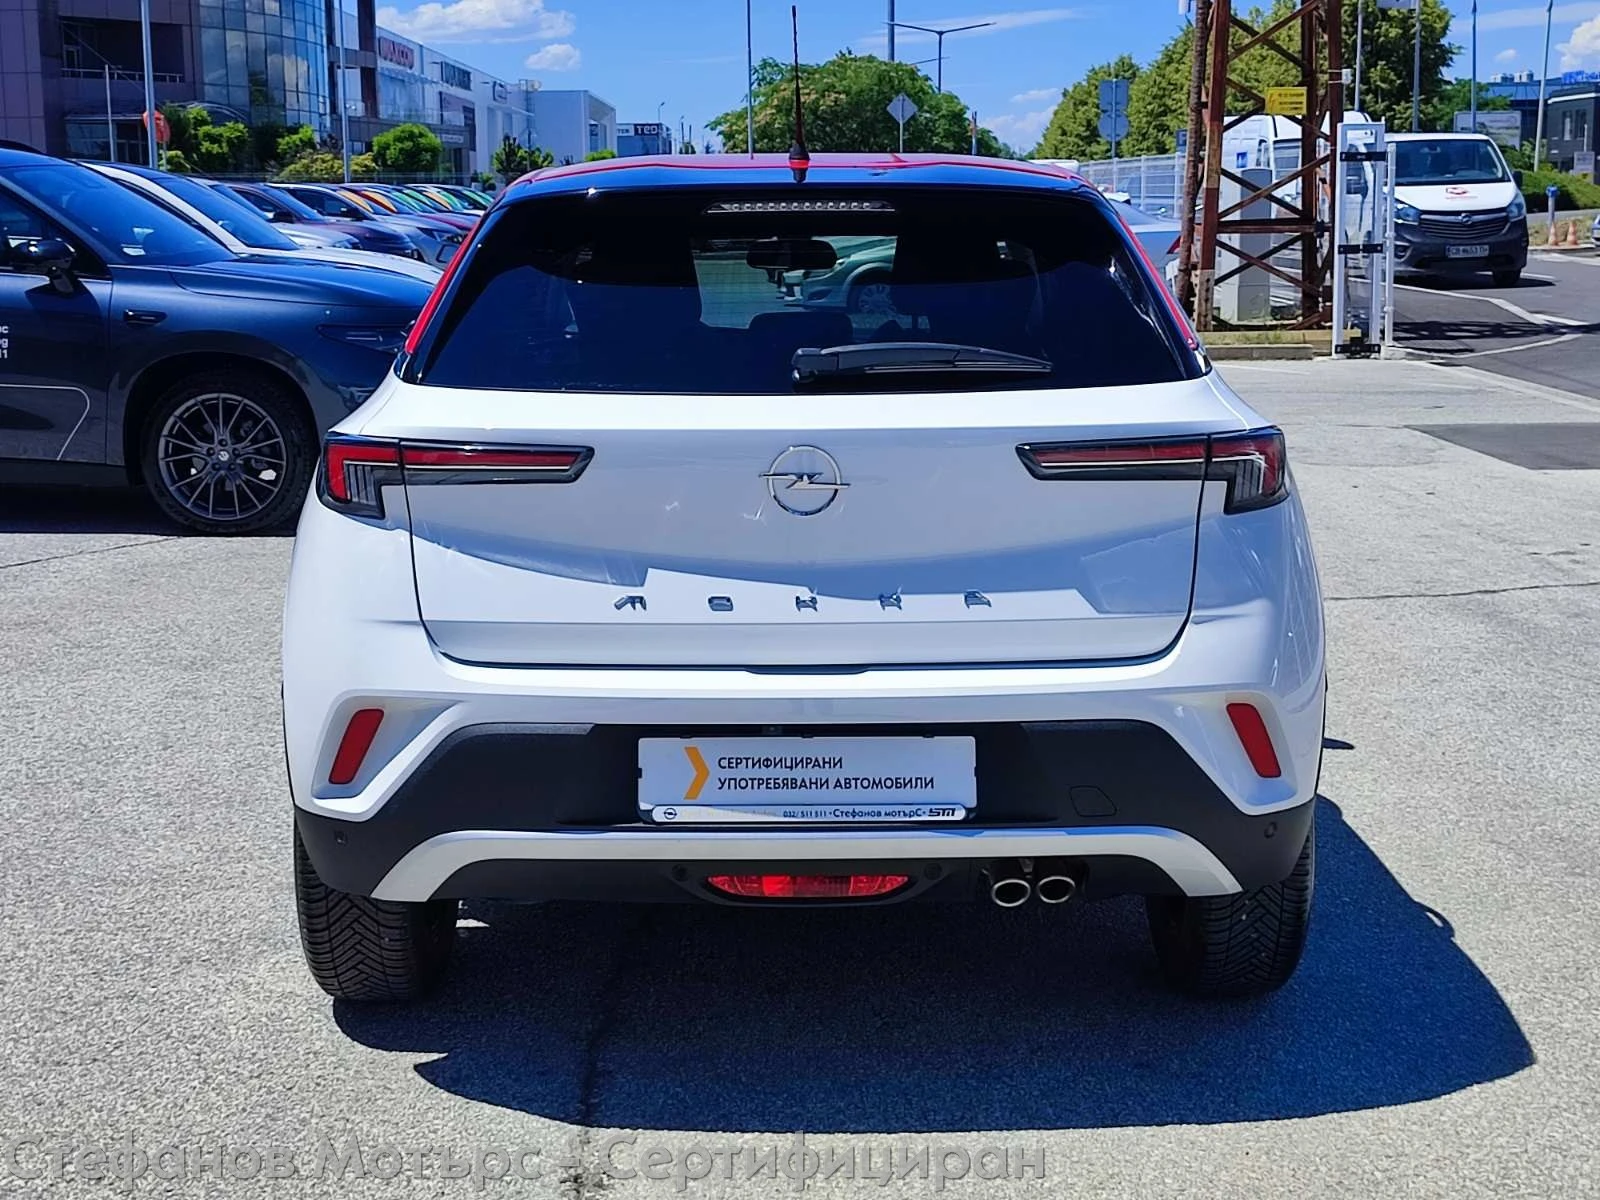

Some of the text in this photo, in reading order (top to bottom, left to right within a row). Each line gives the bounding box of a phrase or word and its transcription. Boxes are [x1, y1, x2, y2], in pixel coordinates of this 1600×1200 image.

[717, 756, 843, 771] СЕРТИФИЦИРАНИ
[717, 776, 935, 791] УПОТРЕБЯВАНИ АВТОМОБИЛИ
